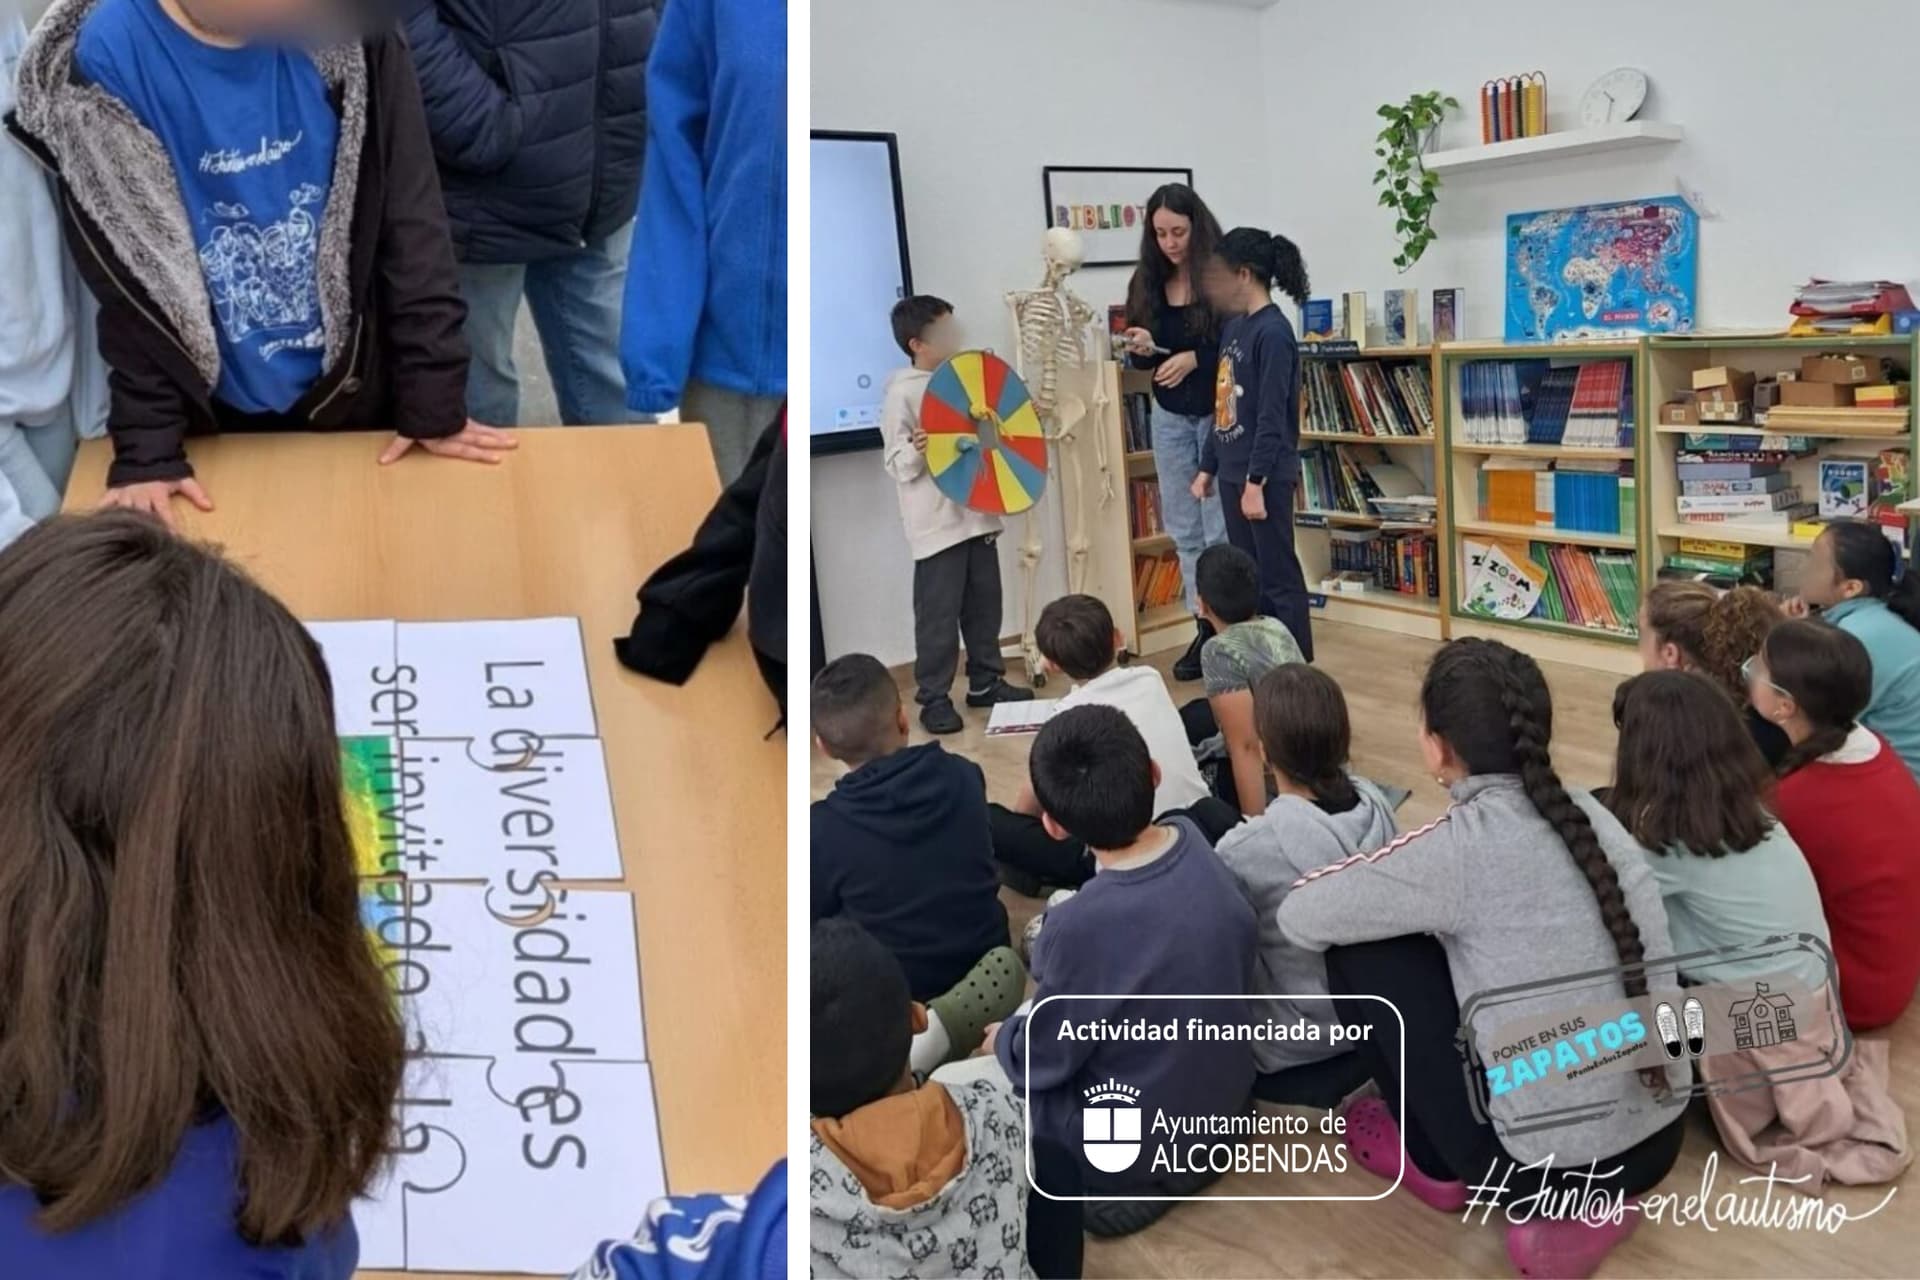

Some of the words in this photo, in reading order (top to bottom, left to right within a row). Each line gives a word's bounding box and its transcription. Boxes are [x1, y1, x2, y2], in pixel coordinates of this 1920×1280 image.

[1488, 560, 1531, 593] ZOOM
[370, 664, 420, 737] ser
[484, 660, 545, 710] La
[373, 752, 452, 997] invitado
[490, 728, 597, 1056] diversidad
[515, 1084, 588, 1171] es
